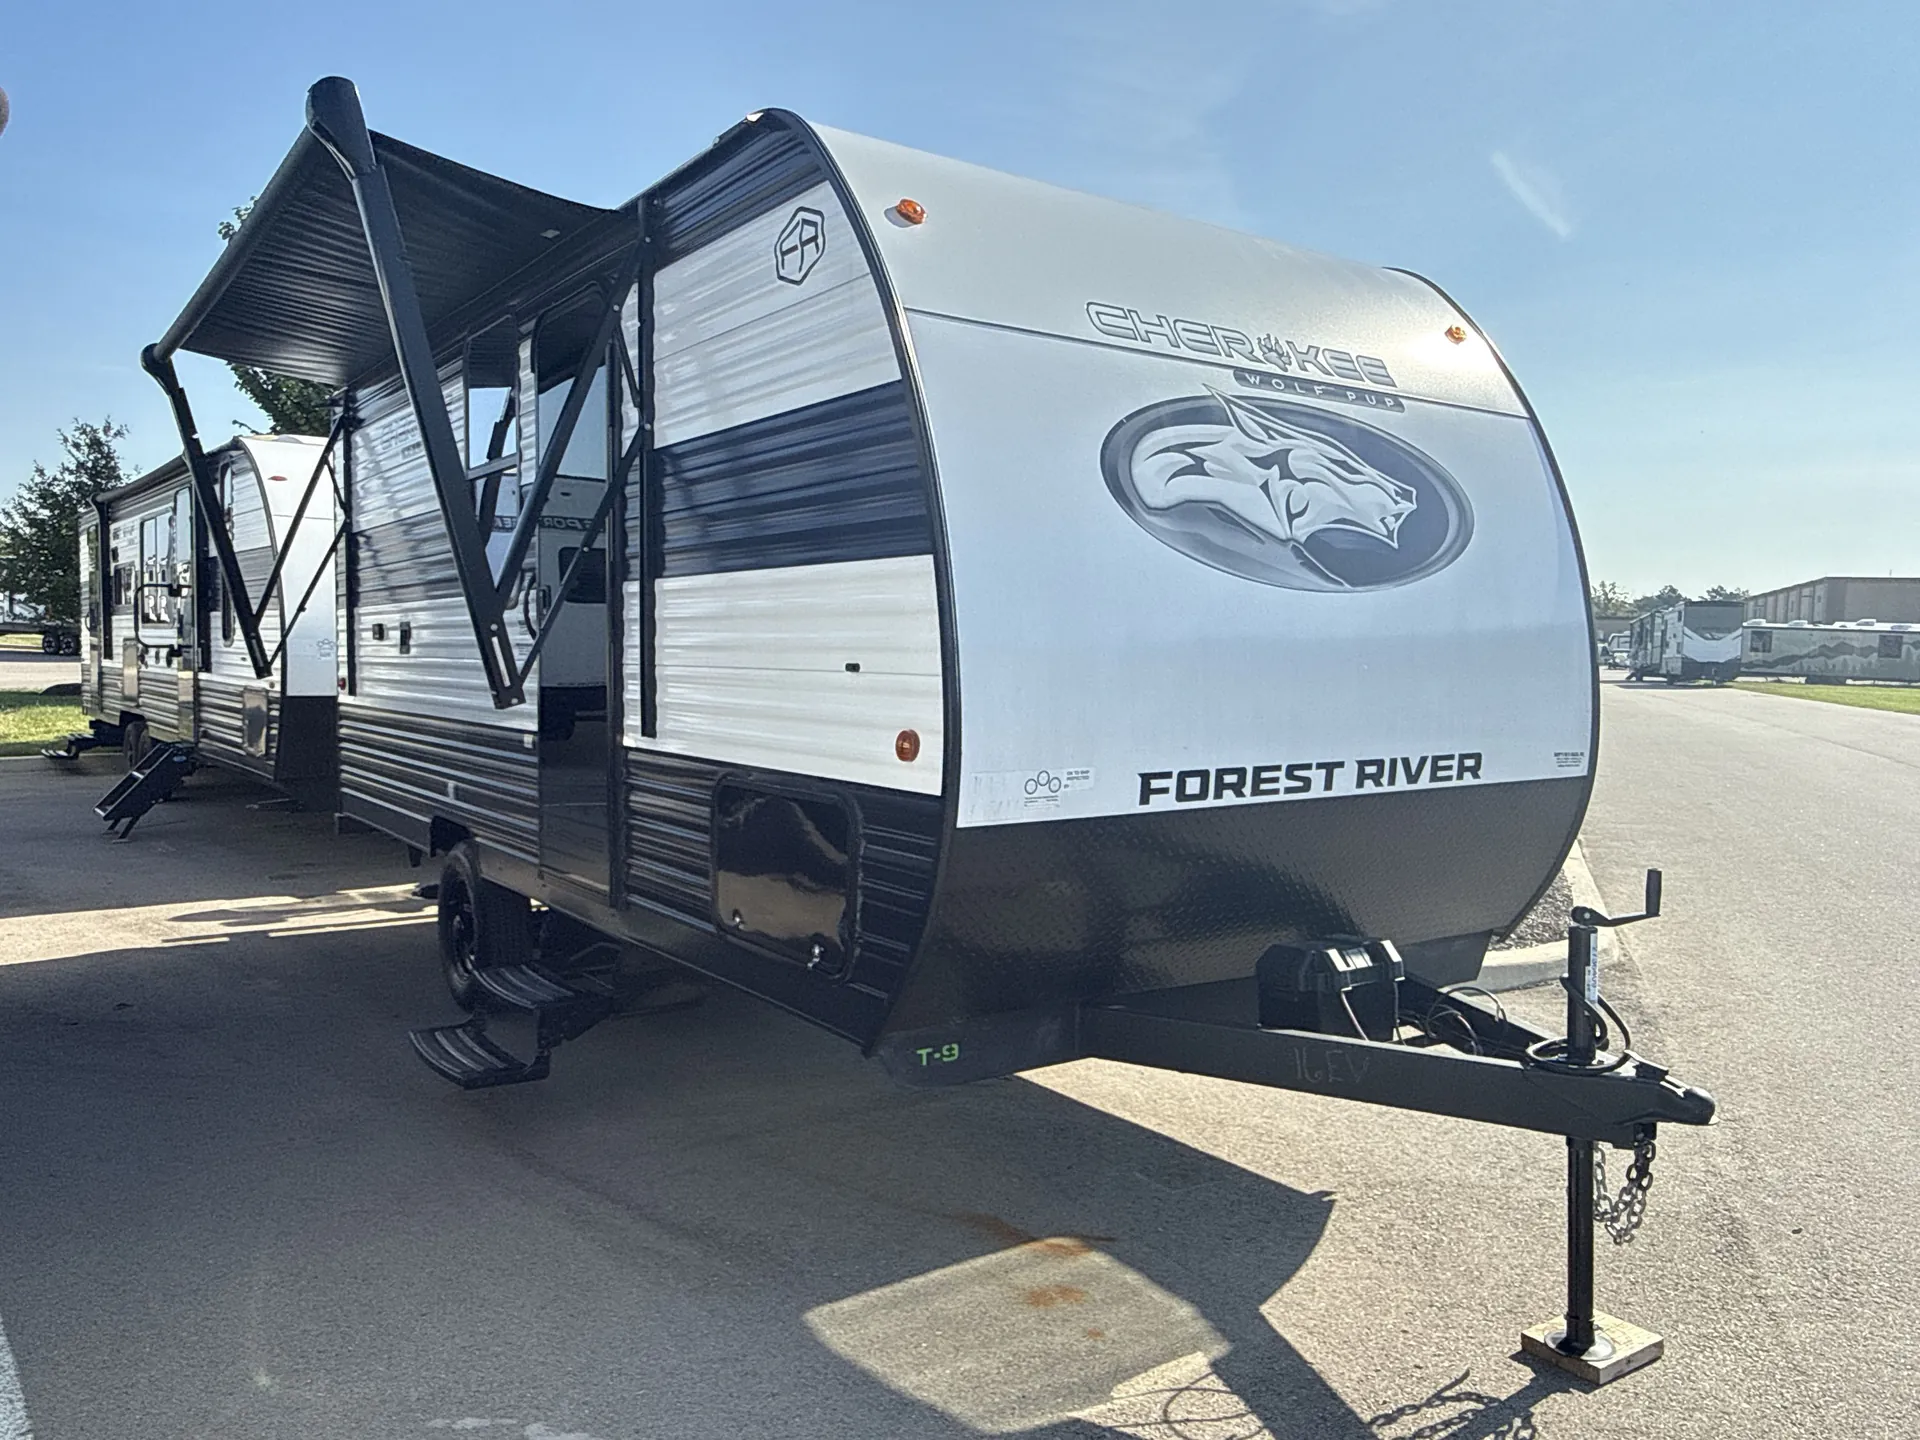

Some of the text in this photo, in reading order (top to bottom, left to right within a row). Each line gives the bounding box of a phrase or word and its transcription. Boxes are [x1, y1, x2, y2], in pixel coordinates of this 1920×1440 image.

[1244, 372, 1395, 408] WOLF PUP
[1137, 752, 1483, 806] FOREST RIVER
[916, 1043, 959, 1066] T-9
